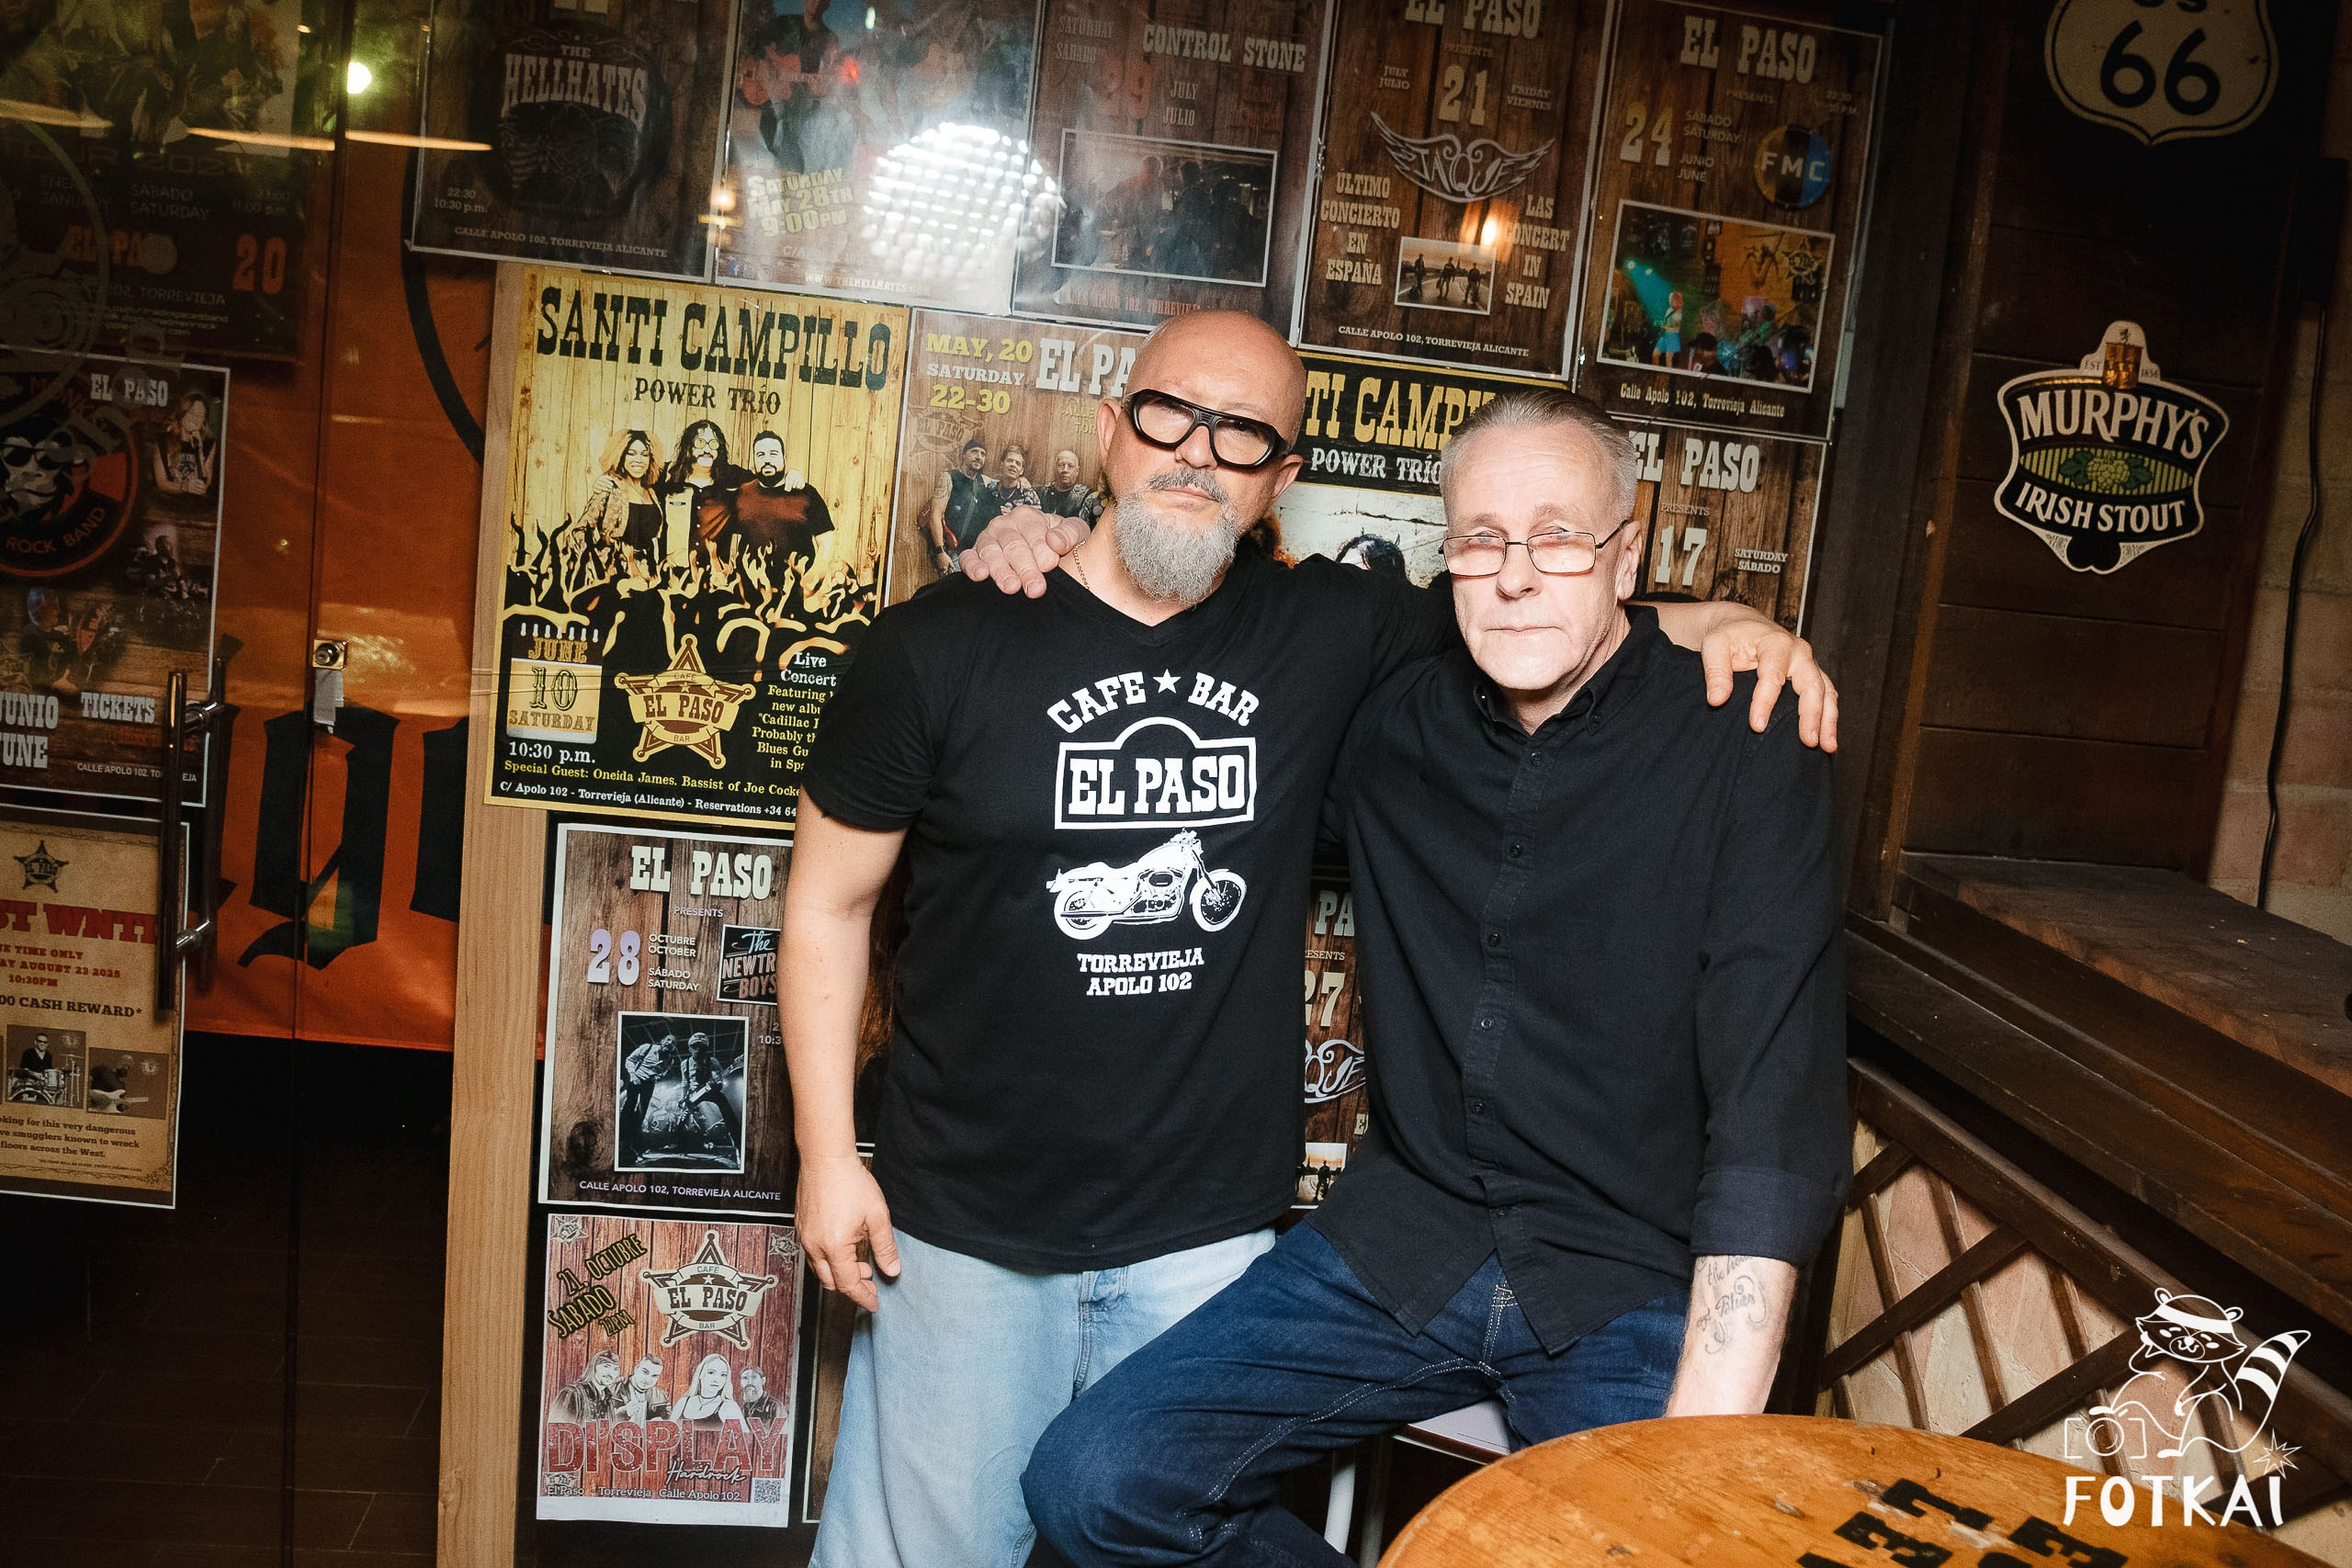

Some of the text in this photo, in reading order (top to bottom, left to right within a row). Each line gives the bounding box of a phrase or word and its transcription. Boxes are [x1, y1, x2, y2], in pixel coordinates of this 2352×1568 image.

[1463, 0, 1542, 39] PASO
[560, 45, 592, 58] THE
[1142, 23, 1307, 73] CONTROL STONE
[1679, 15, 1816, 85] EL PASO
[1384, 65, 1409, 79] JULY
[2100, 19, 2221, 116] 66
[502, 53, 649, 134] HELLHATES
[1170, 81, 1199, 100] JULY
[1378, 77, 1410, 90] JULIO
[1438, 64, 1487, 126] 21
[1510, 85, 1551, 98] FRIDAY
[1162, 106, 1195, 127] JULIO
[1506, 96, 1552, 111] VIERNES
[1620, 101, 1673, 167] 24
[1683, 126, 1741, 144] SATURDAY
[1679, 154, 1714, 169] JUNIO
[747, 167, 843, 198] SATURDAY
[1677, 169, 1708, 184] JUNE
[1320, 199, 1401, 230] CONCIERTO
[1526, 193, 1555, 220] LAS
[454, 226, 669, 259] CALLE APOLO TORREVIEJA ALICANTE
[1347, 231, 1369, 255] EN
[1505, 221, 1571, 253] CONCERT
[232, 233, 288, 294] 20
[1325, 257, 1383, 286] ESPAÑA
[1522, 254, 1543, 278] IN
[1504, 282, 1551, 310] SPAIN
[537, 286, 891, 391] SANTI CAMPILLO
[926, 333, 1034, 364] MAY, 20
[1338, 325, 1530, 357] CALLE APOLO 102, TORREVIEJA ALICANTE
[926, 364, 1025, 387] SATURDAY
[1035, 337, 1081, 394] EL
[90, 372, 114, 401] EL
[123, 377, 169, 408] PASO
[634, 377, 718, 410] POWER
[930, 384, 1012, 414] 22-30
[1620, 382, 1786, 418] Calle Apolo Torrevieja Alicante
[2016, 388, 2211, 460] MURPHY'S
[1310, 447, 1386, 479] POWER
[1680, 437, 1760, 493] PASO
[1660, 503, 1710, 516] PRESENTS
[2014, 480, 2186, 534] IRISH STOUT
[5, 505, 107, 557] ROCK BAND
[1655, 525, 1707, 586] 17
[1734, 547, 1789, 563] SATURDAY
[527, 636, 589, 663] JUNE
[793, 651, 827, 669] Live
[529, 666, 579, 711] 10
[780, 669, 837, 687] Concert
[767, 684, 827, 704] Featuring
[772, 701, 796, 713] new
[1046, 671, 1260, 734] CAFE BAR
[80, 691, 155, 724] TICKETS
[509, 709, 596, 732] SATURDAY
[643, 694, 725, 724] EL PASO
[752, 726, 803, 744] Probably
[756, 741, 788, 755] Blues
[509, 741, 596, 764] 10:30 p.m.
[770, 757, 782, 768] in
[76, 761, 132, 776] CALLE APOLO
[504, 760, 765, 794] Special Guest: Oneida Bassist of Joe
[1069, 754, 1246, 816] EL PASO
[500, 781, 782, 816] C/ Apolo 102 Torrevieja (Alicante) Reservations +34
[630, 845, 773, 900] EL PASO
[673, 905, 724, 918] PRESENTS
[15, 945, 84, 960] TIME ONLY
[648, 946, 696, 958] OCTOBER
[649, 933, 696, 946] OCTUBRE
[20, 960, 120, 978] AUGUST 23 2025
[588, 928, 640, 986] 28
[1077, 947, 1204, 974] TORREVIEJA
[8, 974, 59, 987] 10:30PM
[648, 965, 691, 980] SÁBADO
[648, 979, 699, 991] SATURDAY
[1086, 971, 1193, 997] APOLO 102
[739, 975, 778, 999] BOYS
[18, 997, 62, 1011] CASH
[27, 1117, 136, 1135] for this very dangerous
[1, 1140, 106, 1157] floors across the West.
[13, 1131, 140, 1148] smugglers known wreck
[580, 1180, 782, 1201] CALLE APOLO 102, TORREVIEJA ALICANTE
[584, 1234, 648, 1280] OCTUBRE
[548, 1284, 616, 1338] SABADO
[668, 1287, 748, 1311] EL PASO
[666, 1460, 746, 1484] Hardrock
[560, 1485, 741, 1501] Paso Torrevieja Calle Apolo 102
